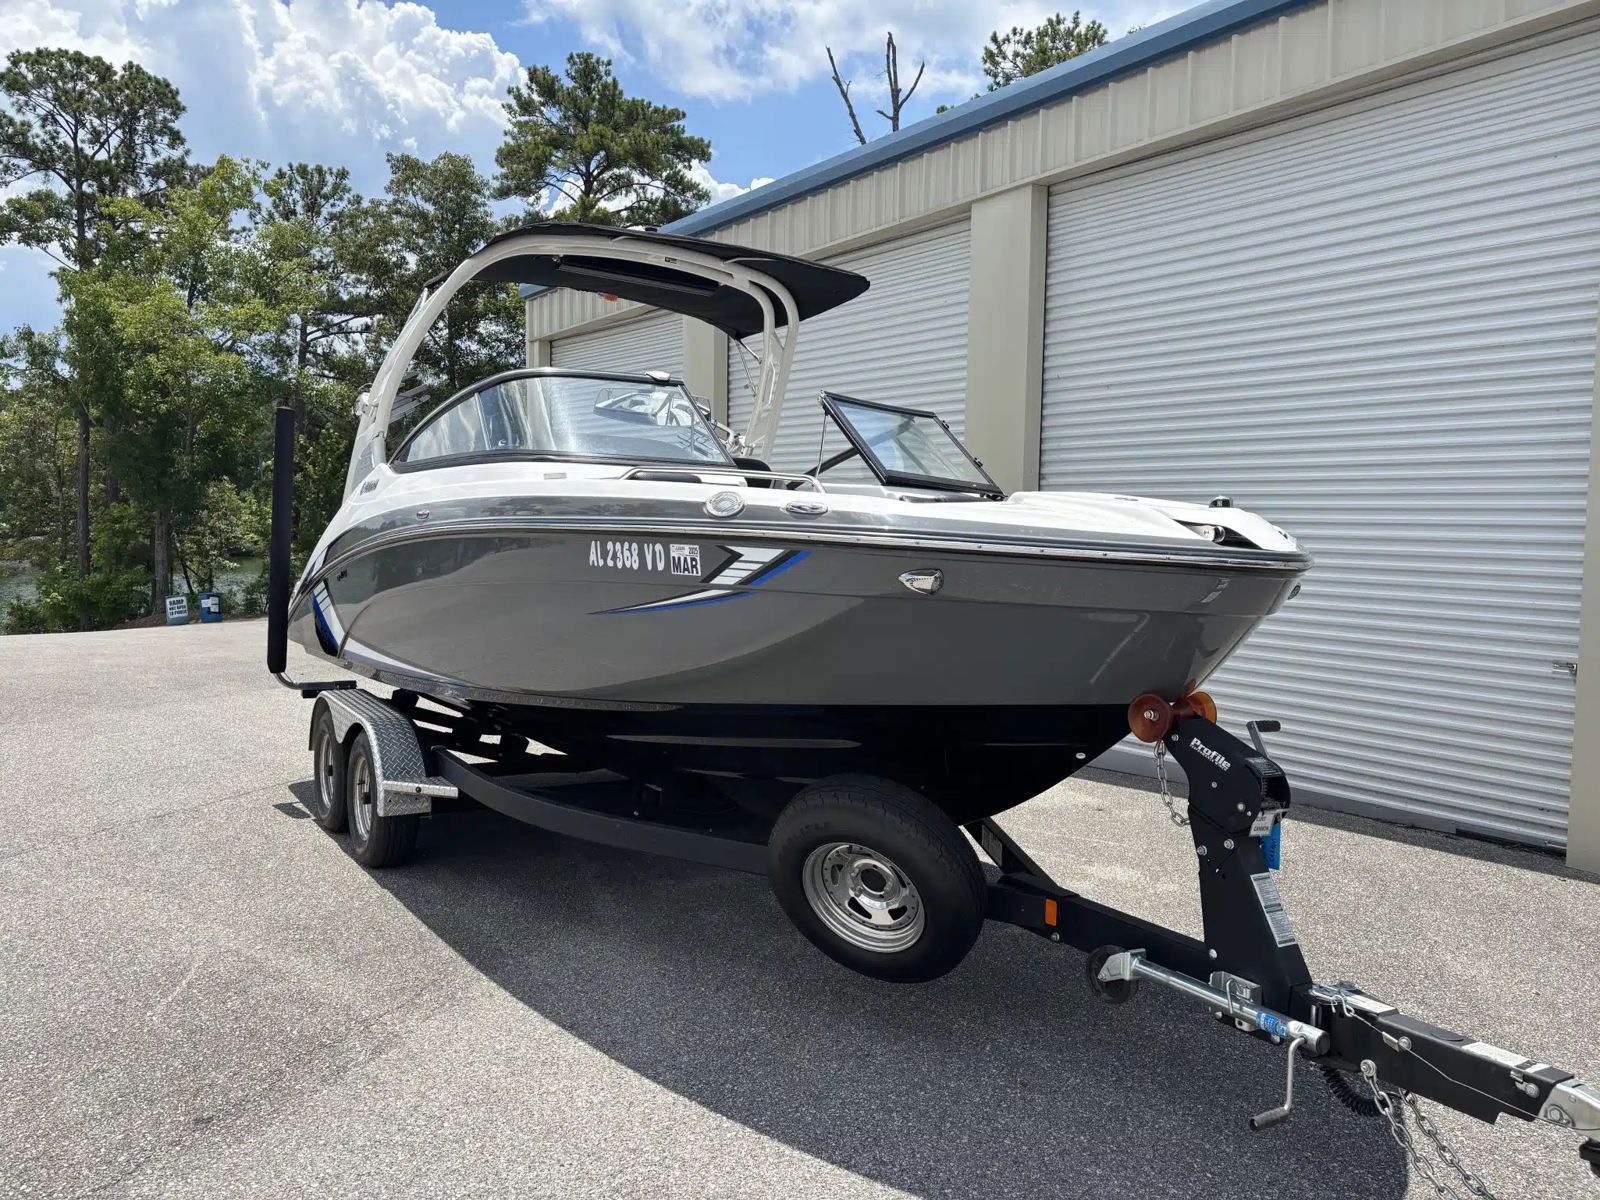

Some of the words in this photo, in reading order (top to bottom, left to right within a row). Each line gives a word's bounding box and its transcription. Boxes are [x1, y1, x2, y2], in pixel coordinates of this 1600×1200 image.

[589, 540, 604, 567] AL
[606, 541, 639, 570] 2368
[672, 556, 699, 574] MAR
[1190, 737, 1231, 769] Profile
